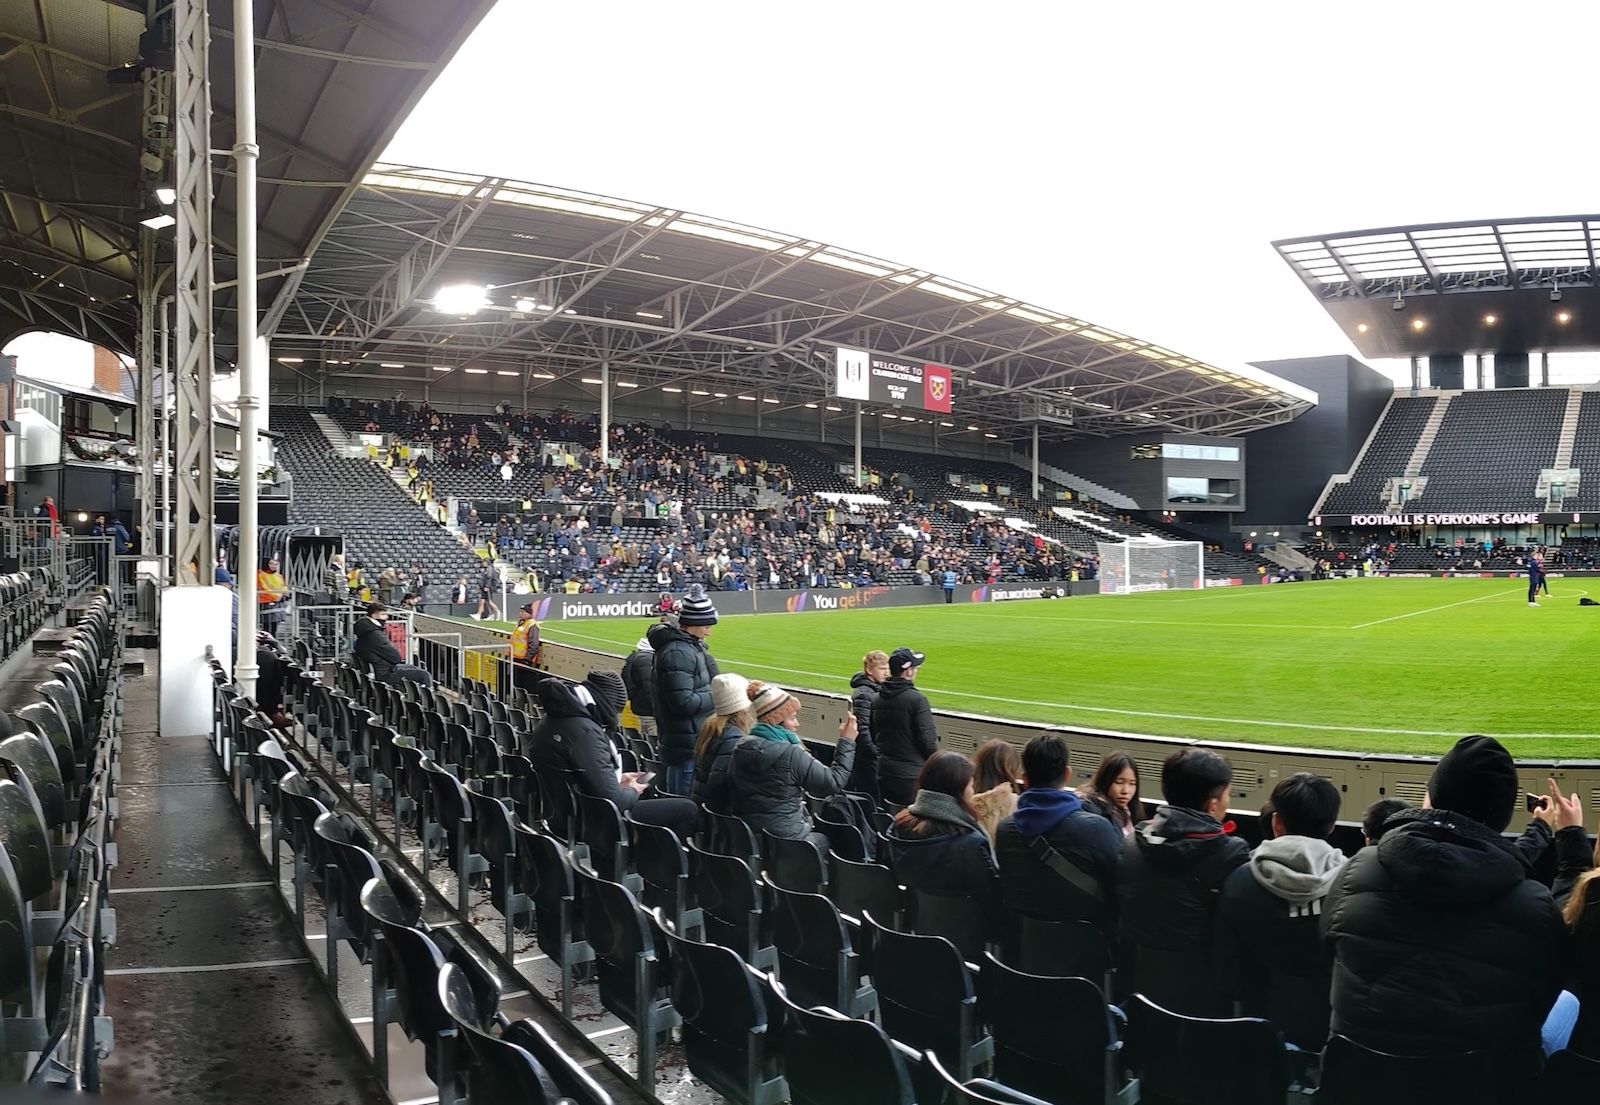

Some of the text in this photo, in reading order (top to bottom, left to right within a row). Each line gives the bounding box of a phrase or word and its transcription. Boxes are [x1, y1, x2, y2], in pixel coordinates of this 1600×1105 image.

[872, 360, 923, 376] WELCOME TO
[1351, 514, 1539, 525] FOOTBALL IS EVERYONE'S GAME
[812, 594, 838, 608] You
[562, 600, 653, 620] join.worldm
